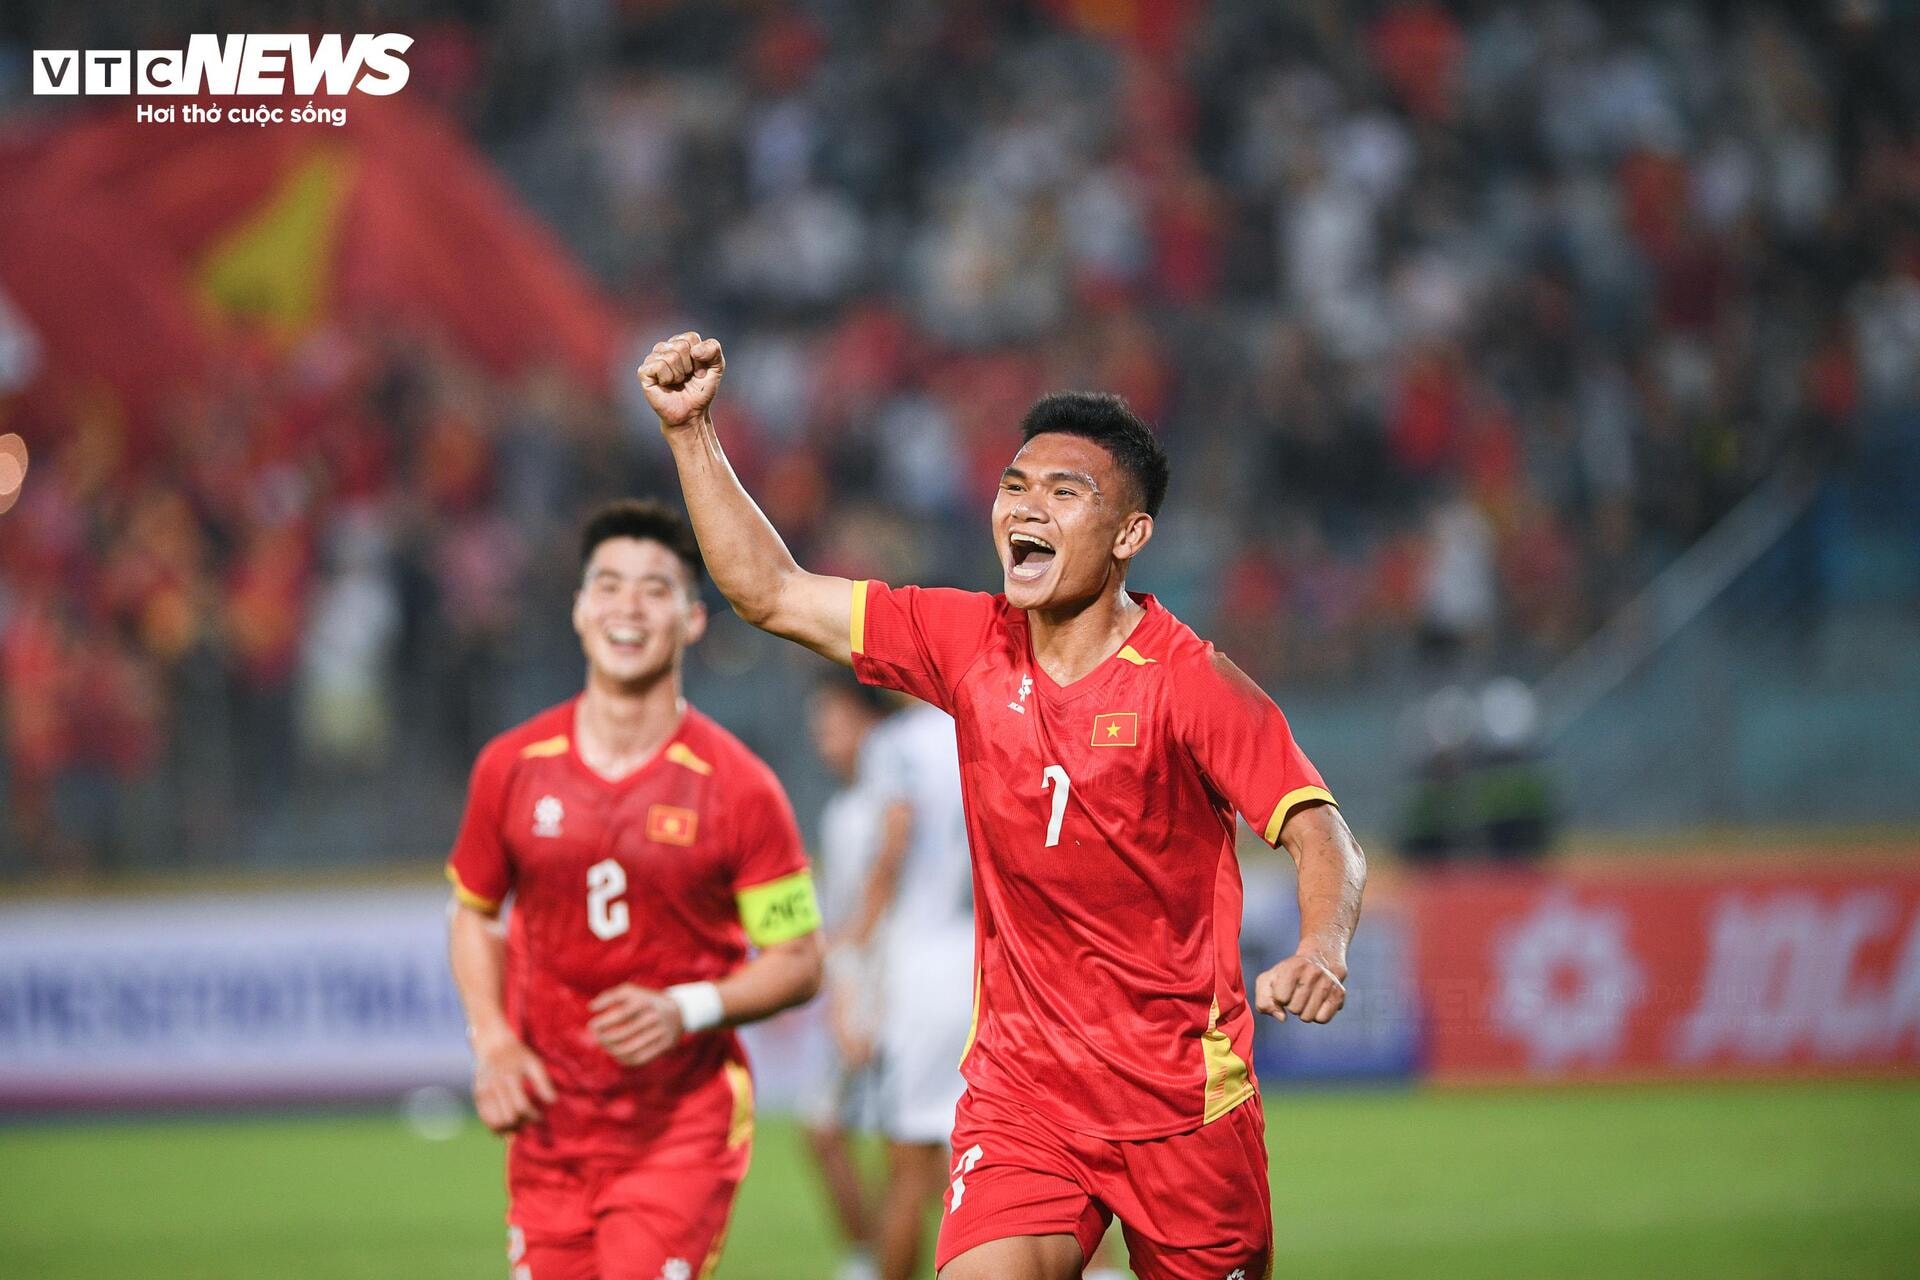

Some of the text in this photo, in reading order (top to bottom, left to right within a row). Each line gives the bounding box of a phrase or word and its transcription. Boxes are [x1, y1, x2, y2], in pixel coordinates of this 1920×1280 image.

[1041, 765, 1071, 847] 7
[587, 858, 630, 941] 2
[950, 1144, 984, 1215] 7
